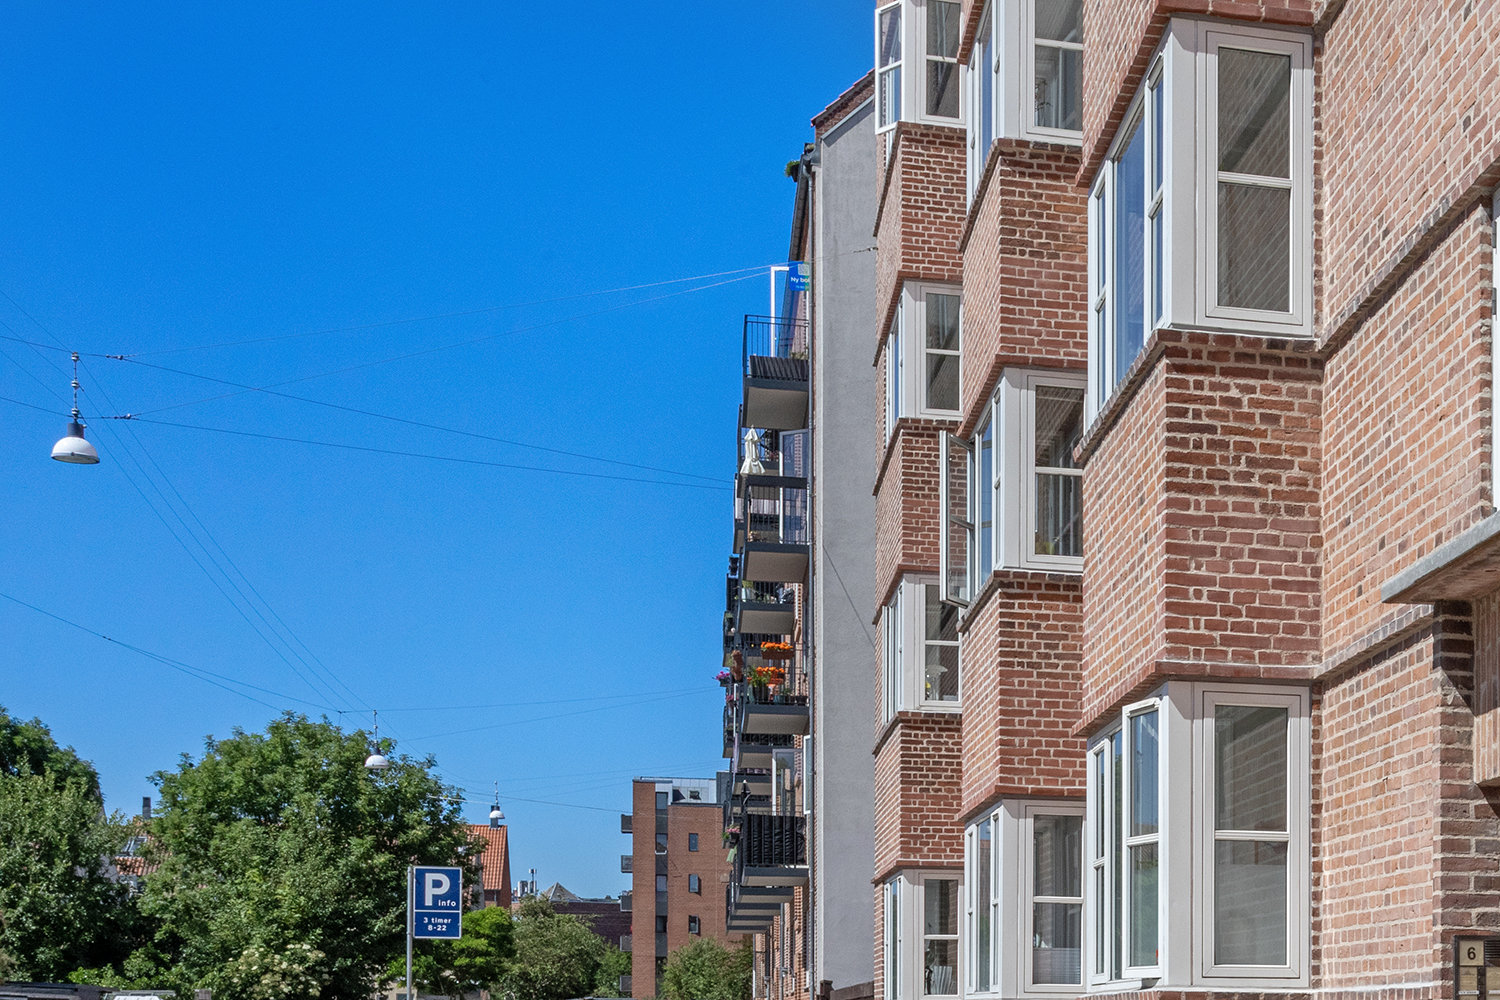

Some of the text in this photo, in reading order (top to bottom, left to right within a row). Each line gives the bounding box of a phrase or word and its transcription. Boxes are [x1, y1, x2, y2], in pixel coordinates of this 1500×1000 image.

[425, 872, 451, 906] P
[438, 899, 457, 907] info
[1467, 946, 1476, 960] 6
